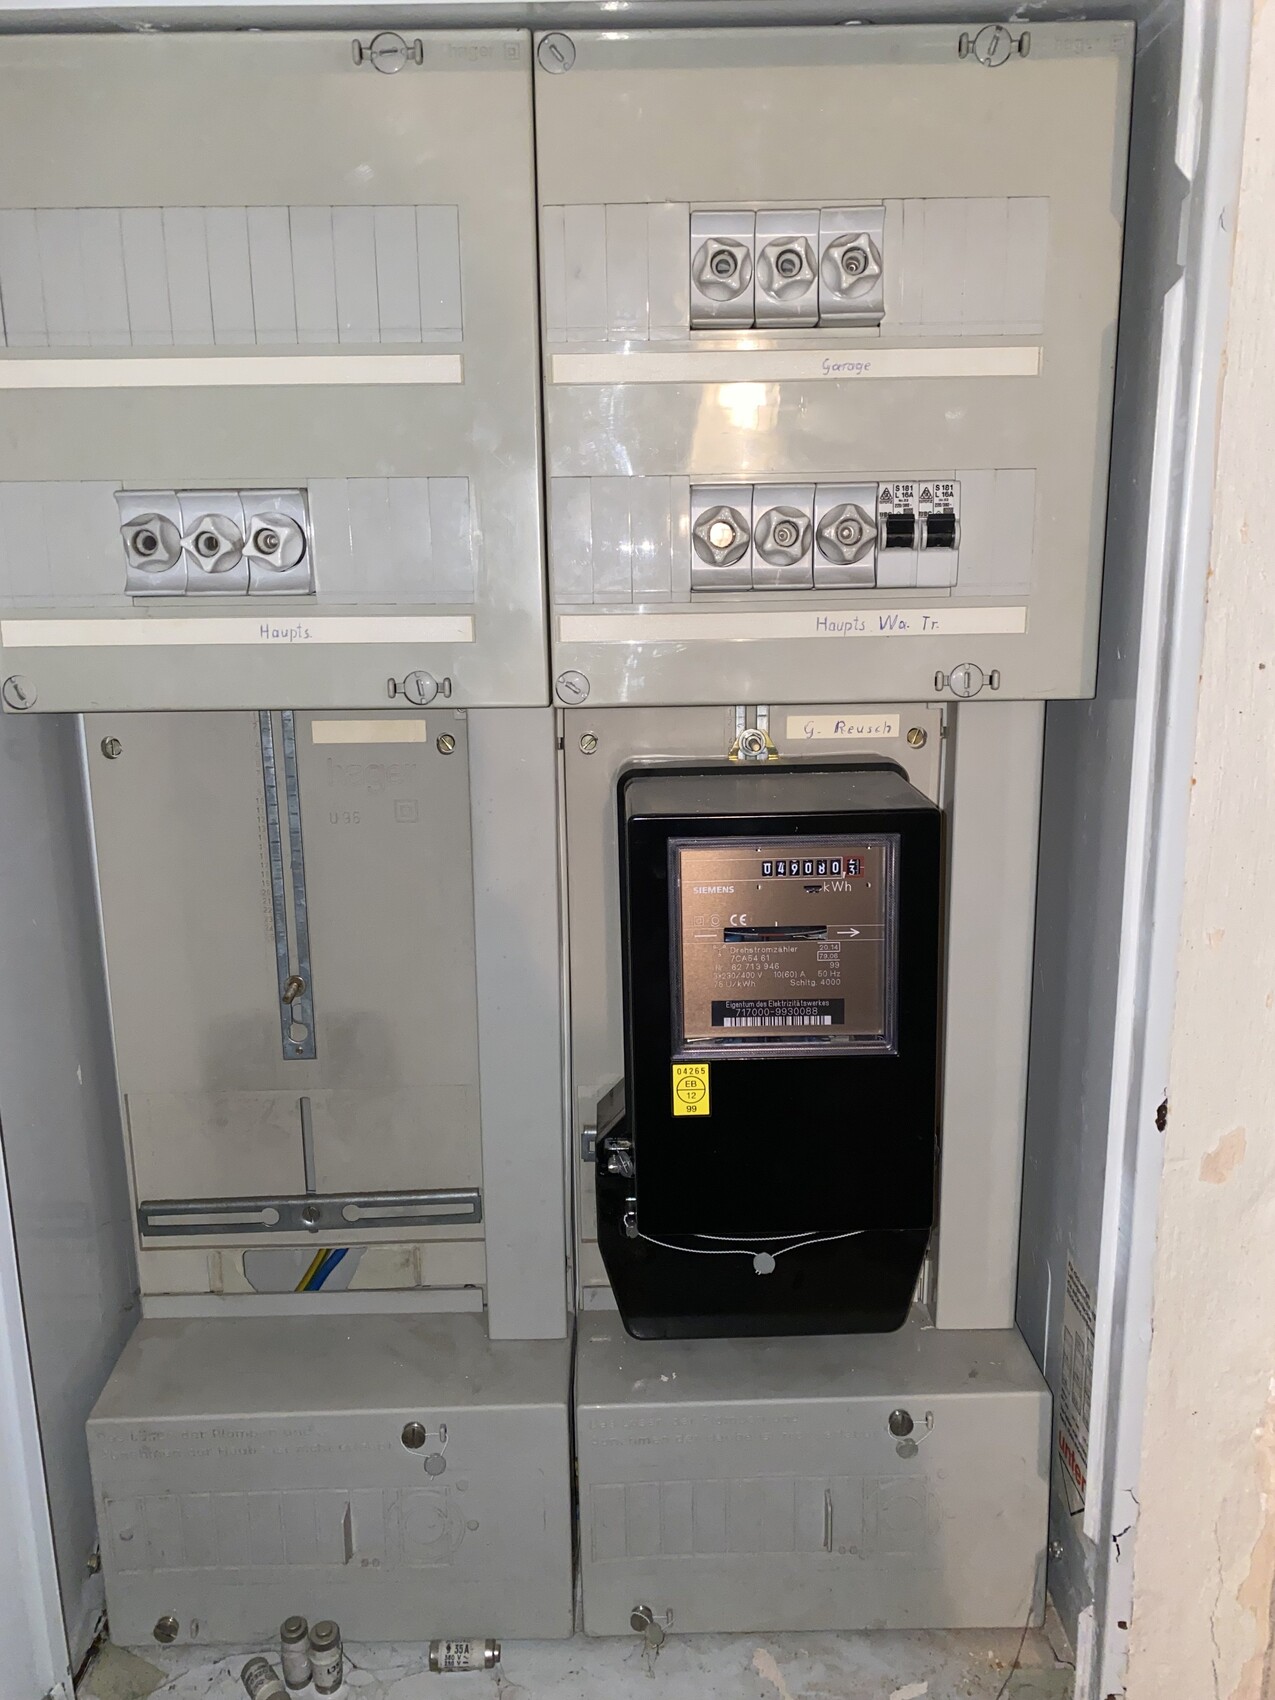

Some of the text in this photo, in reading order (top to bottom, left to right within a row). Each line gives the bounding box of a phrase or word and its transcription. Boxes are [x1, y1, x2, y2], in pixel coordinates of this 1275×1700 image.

[822, 358, 871, 376] Garage
[693, 885, 735, 894] SIEMENS
[823, 881, 852, 892] kWh
[820, 978, 841, 986] 4000
[725, 1000, 755, 1009] Eigentum
[735, 1007, 818, 1016] 717000-9930088
[676, 1067, 706, 1075] 04265
[685, 1080, 697, 1088] EB
[687, 1091, 697, 1099] 12
[686, 1105, 697, 1113] 99
